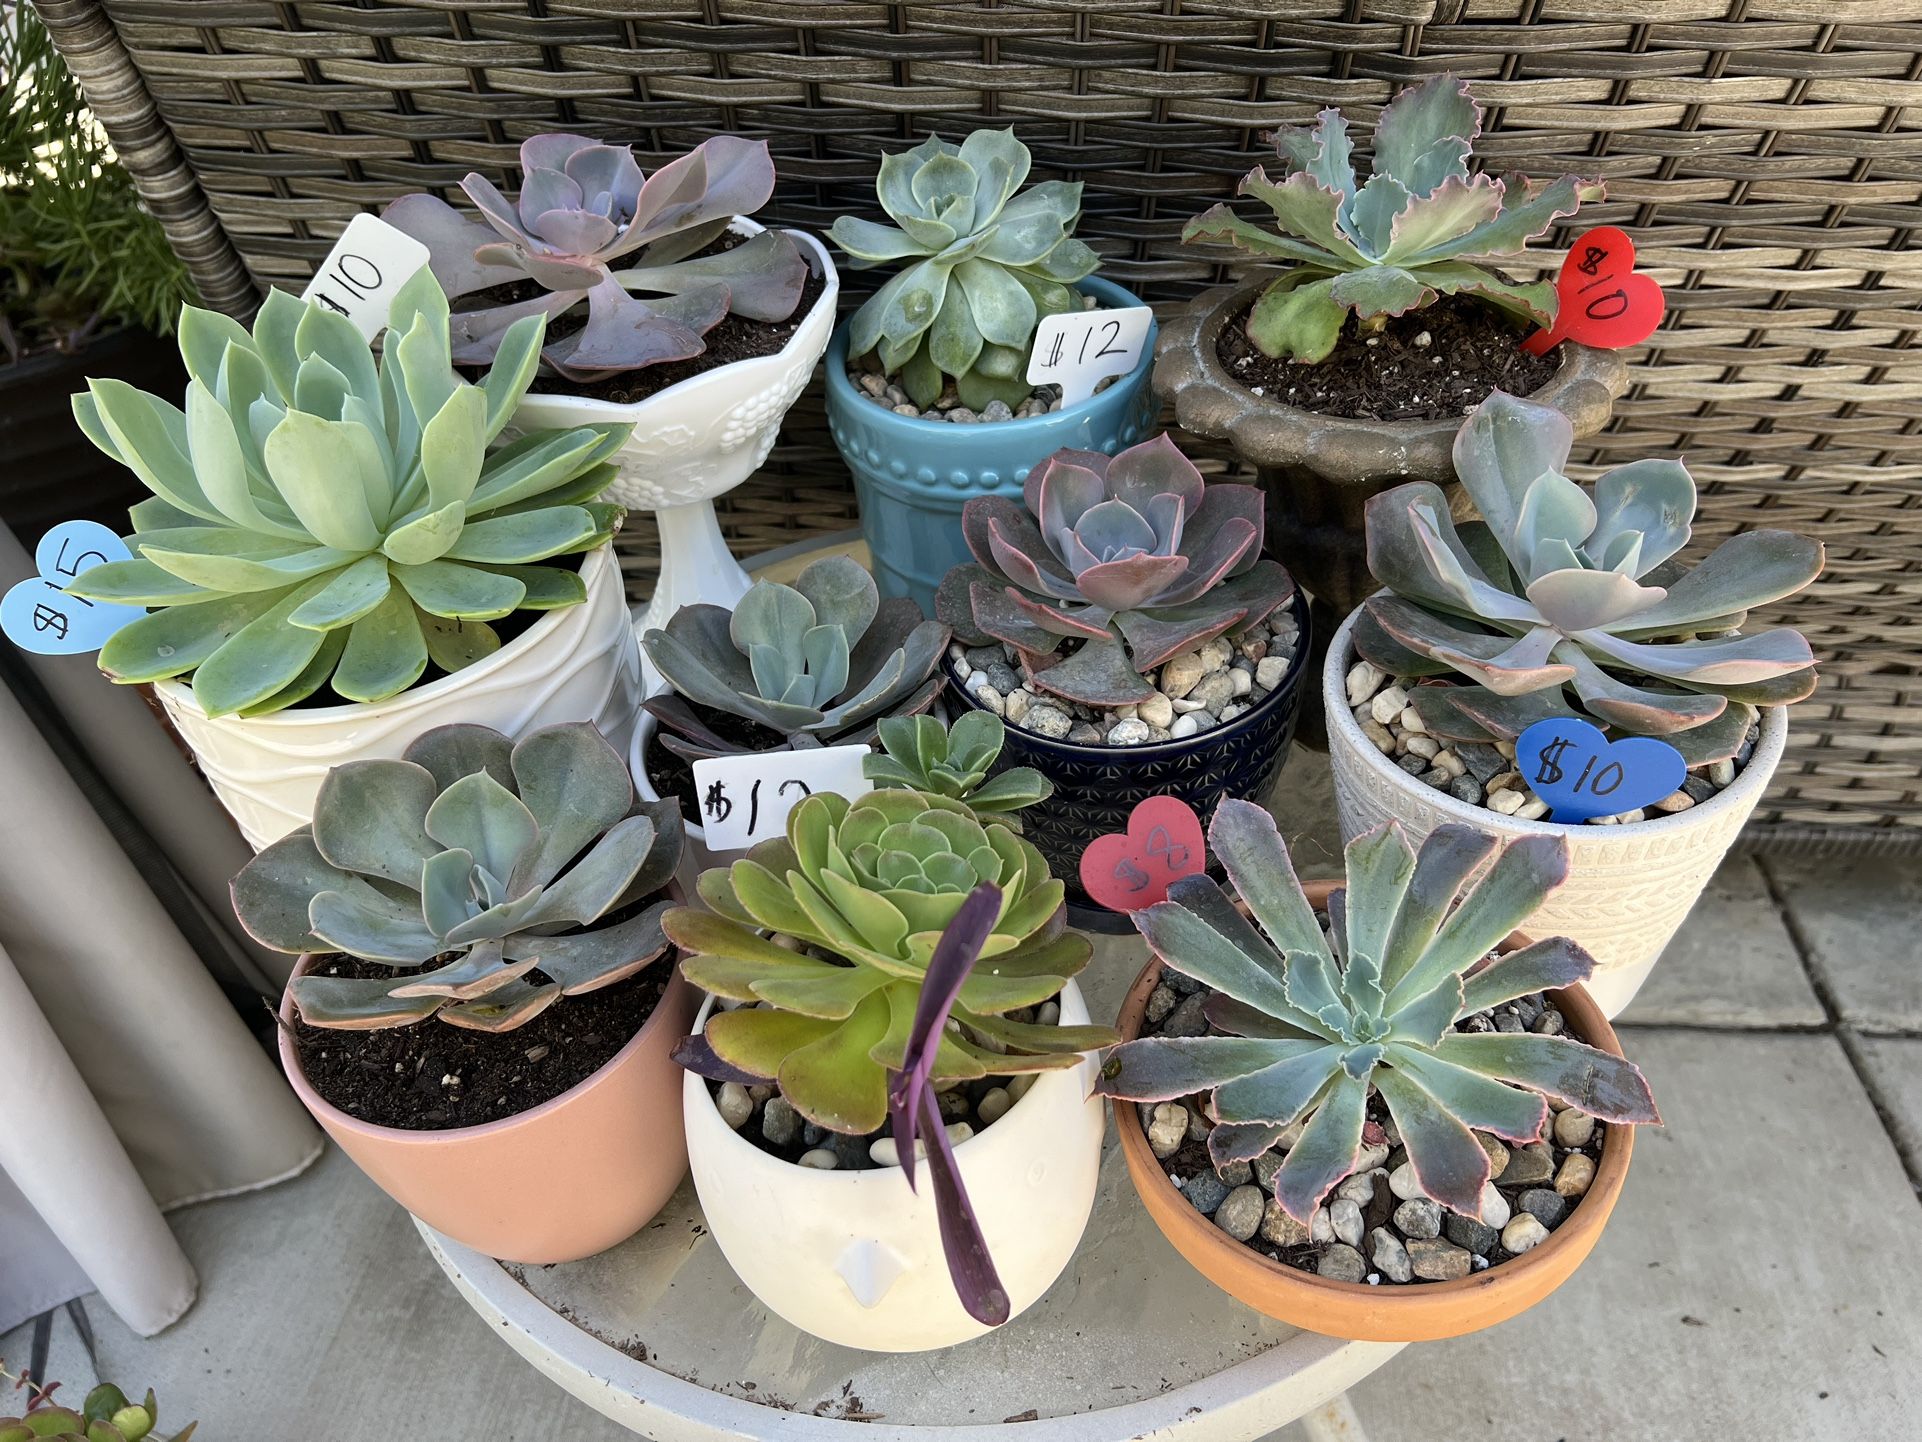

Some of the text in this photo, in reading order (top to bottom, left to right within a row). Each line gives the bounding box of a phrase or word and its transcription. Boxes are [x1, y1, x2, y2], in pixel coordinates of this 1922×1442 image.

[1577, 246, 1628, 320] $10
[1040, 320, 1128, 368] $12
[34, 537, 108, 640] $15
[1534, 736, 1624, 796] $10
